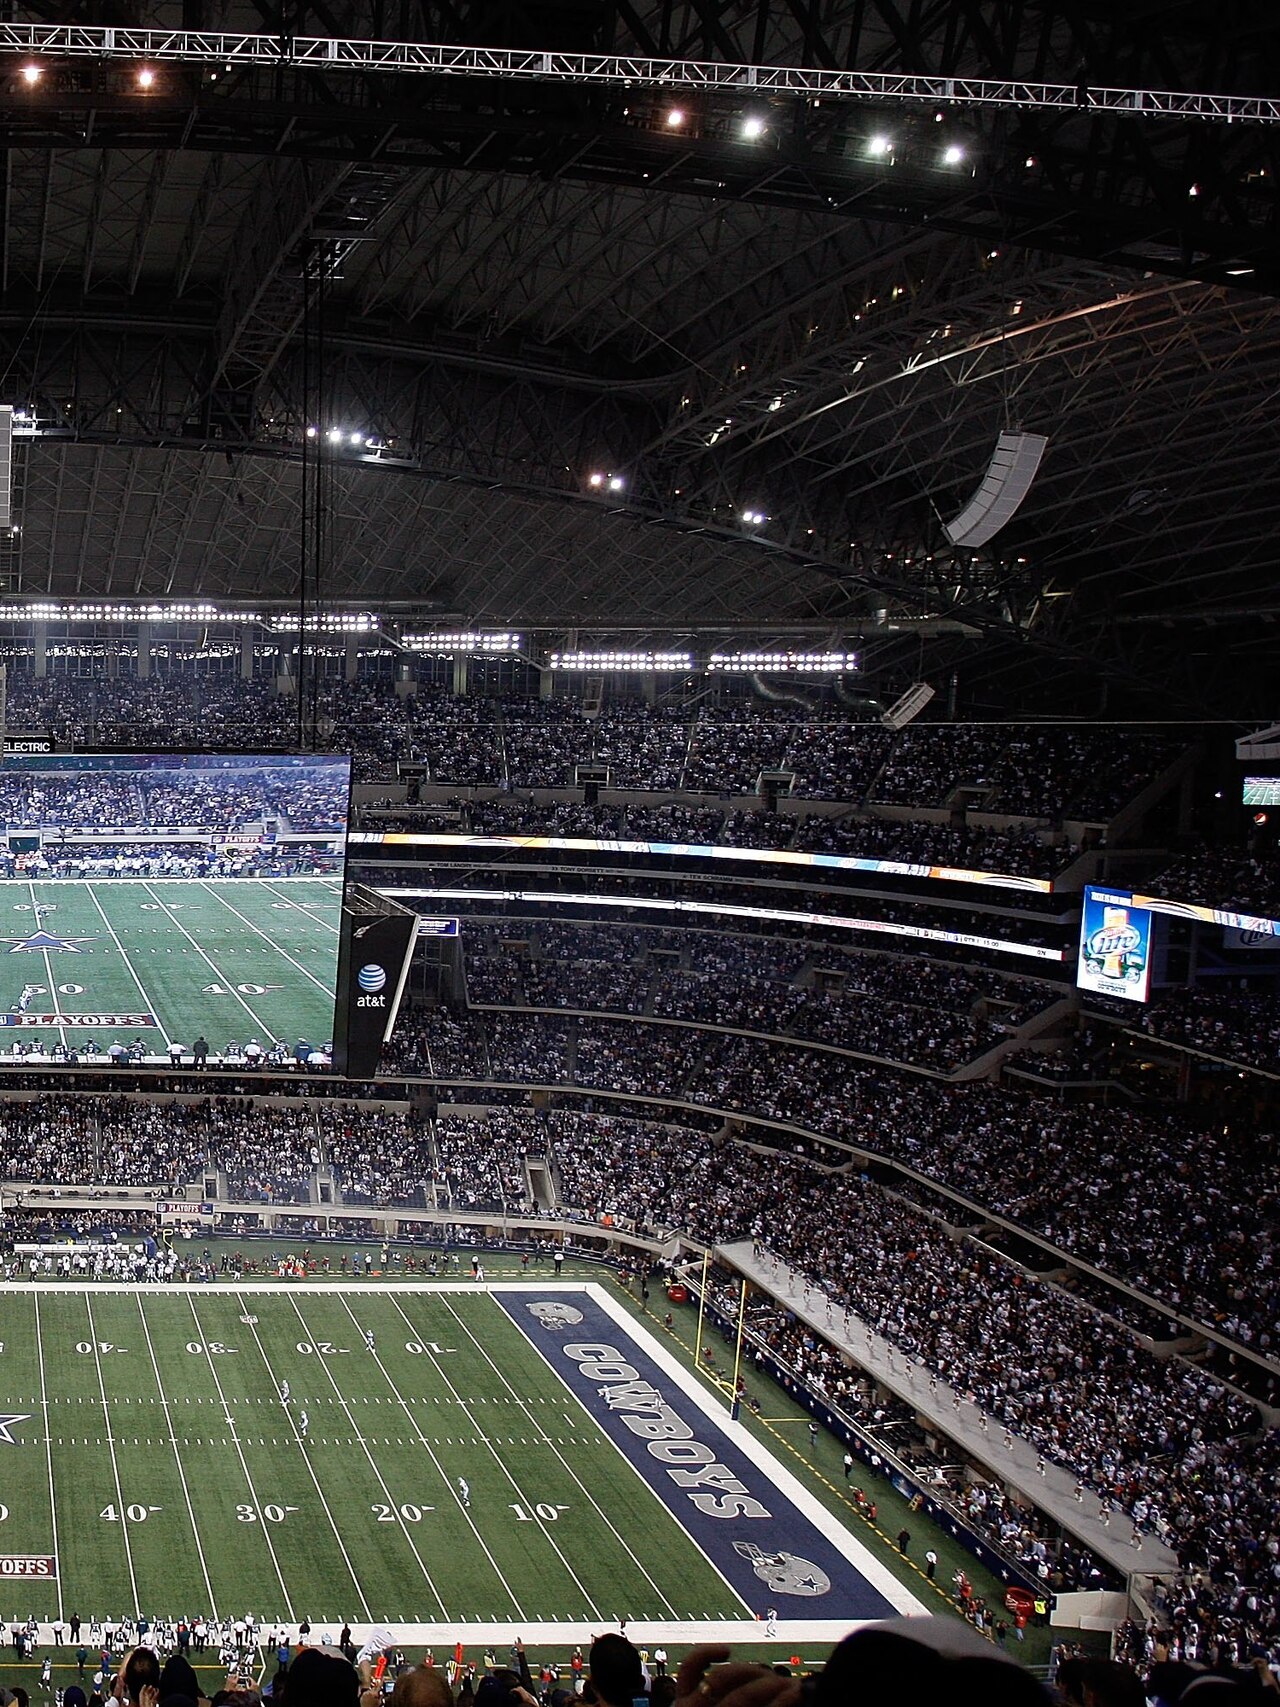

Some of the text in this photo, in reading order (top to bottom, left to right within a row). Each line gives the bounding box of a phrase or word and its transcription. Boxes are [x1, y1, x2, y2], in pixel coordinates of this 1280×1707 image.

[2, 742, 50, 752] ELECTRIC
[201, 983, 266, 995] 40
[357, 995, 386, 1007] at&t
[20, 1015, 146, 1026] PLAYOFFS
[168, 1204, 200, 1213] PLAYOFFS
[562, 1343, 773, 1518] COWBOYS
[99, 1503, 148, 1522] 40
[235, 1504, 288, 1522] 30
[370, 1503, 423, 1522] 20
[508, 1503, 557, 1521] 10
